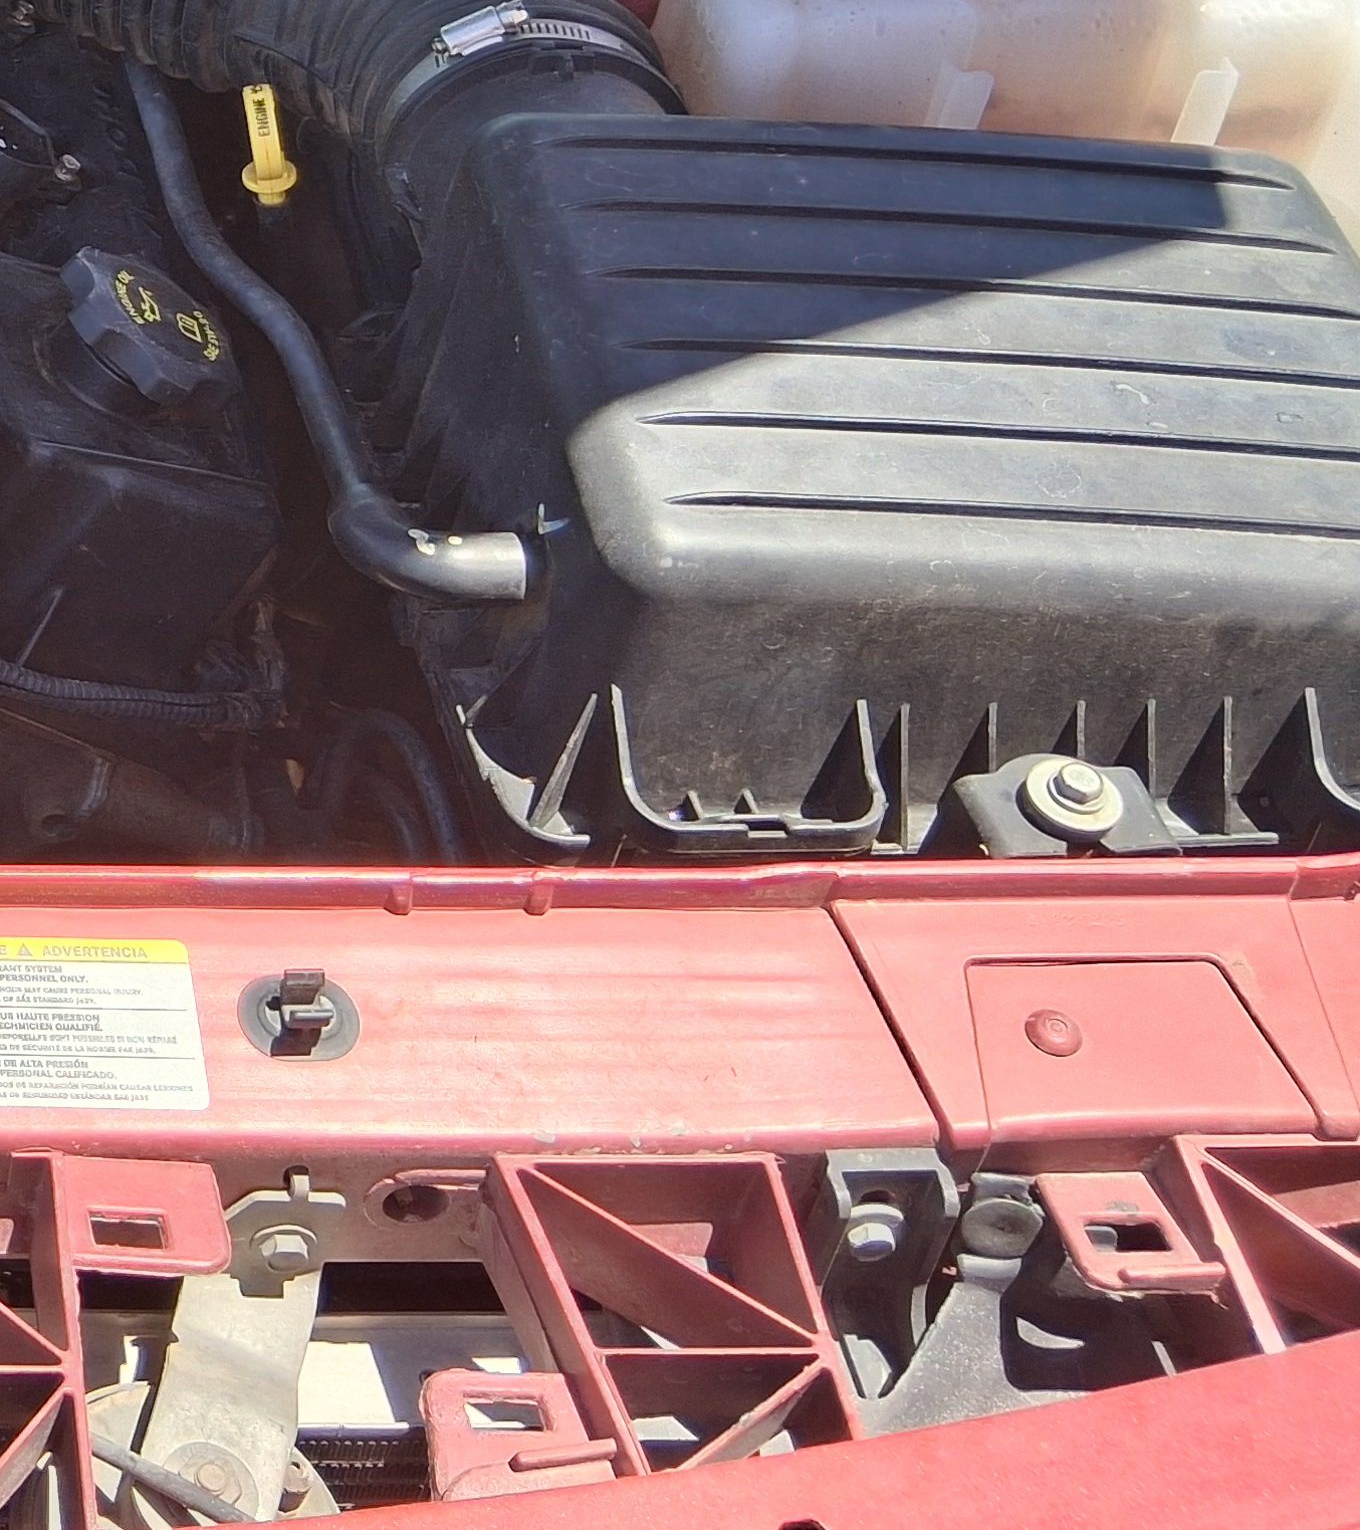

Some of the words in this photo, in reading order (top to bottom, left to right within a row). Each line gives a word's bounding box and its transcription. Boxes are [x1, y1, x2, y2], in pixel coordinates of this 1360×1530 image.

[252, 97, 270, 137] ENGINE
[115, 280, 146, 325] ENGINE
[42, 945, 148, 958] ADVERTENCIA
[59, 974, 89, 983] ONLY.
